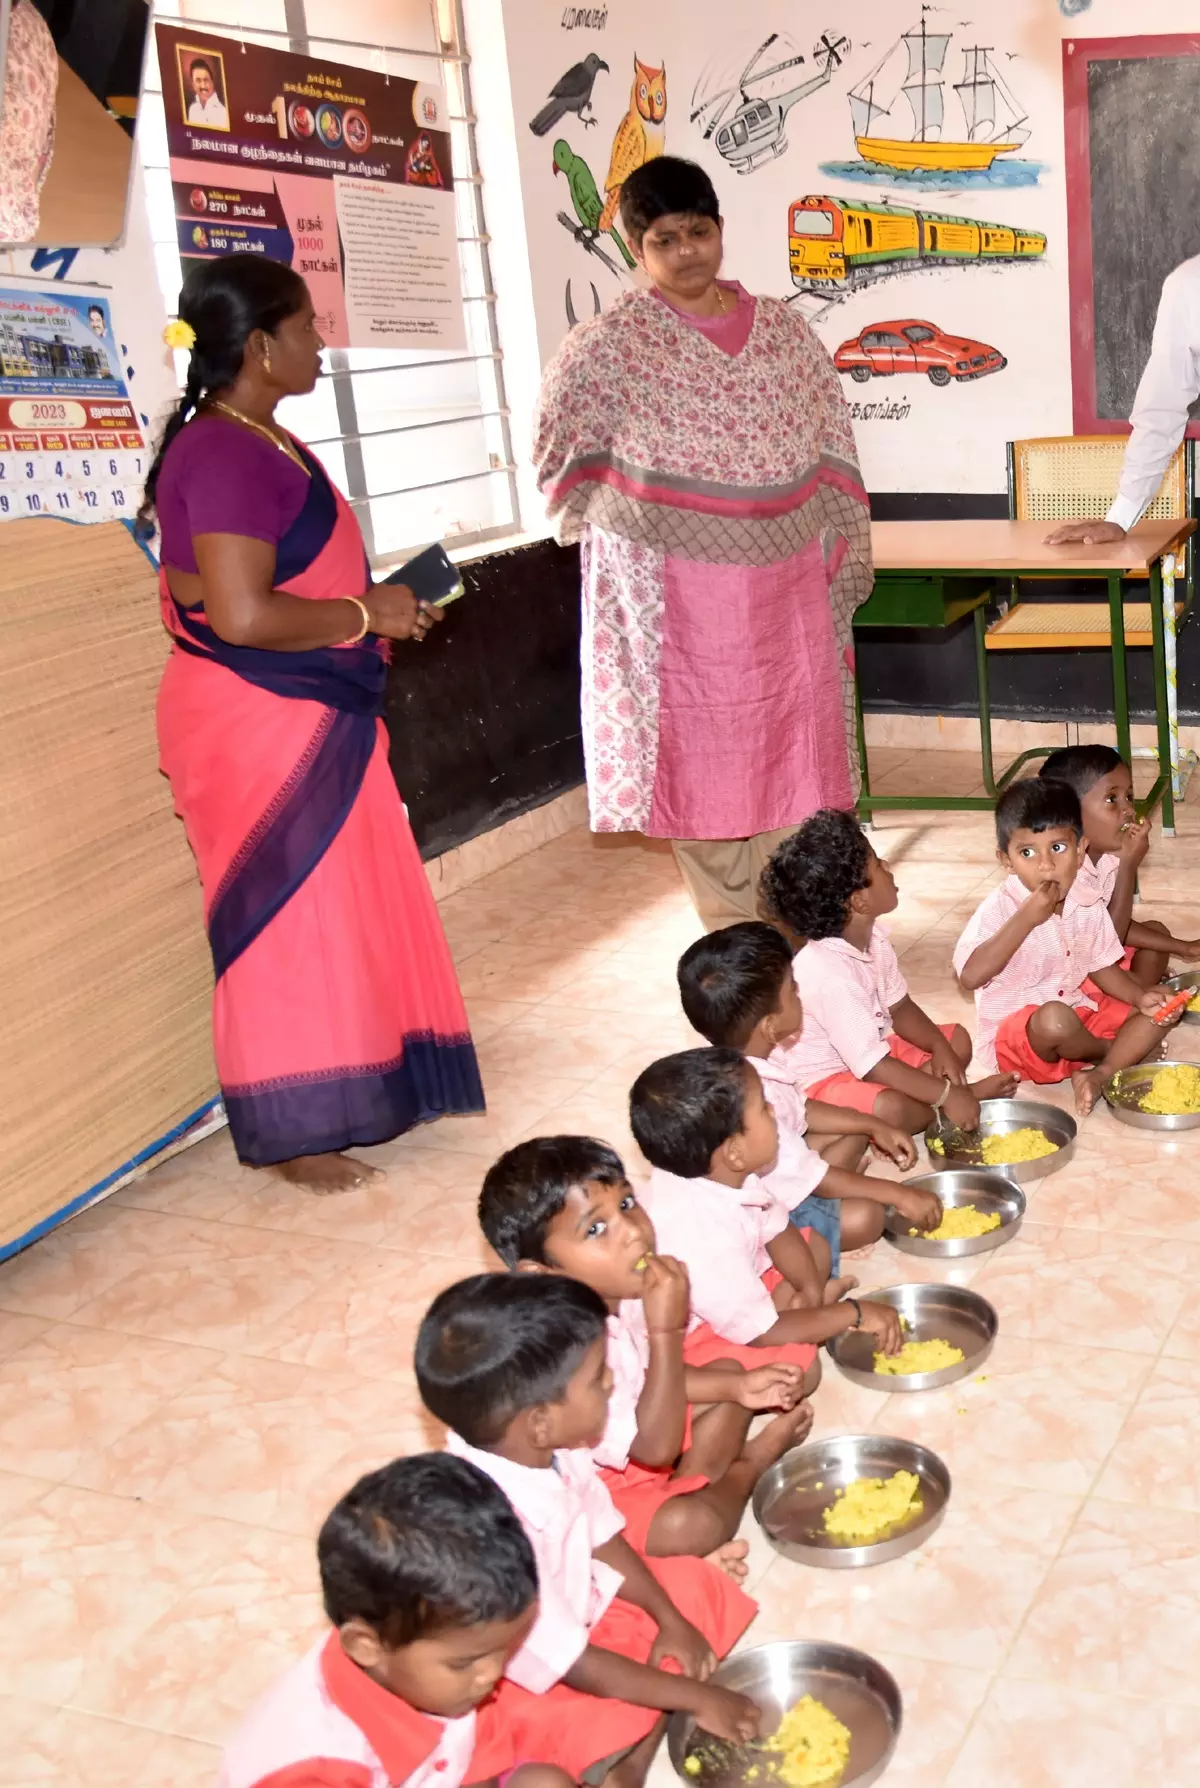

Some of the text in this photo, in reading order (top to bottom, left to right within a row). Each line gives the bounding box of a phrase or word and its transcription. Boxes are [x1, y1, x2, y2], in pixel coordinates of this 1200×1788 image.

[244, 111, 276, 124] முதல்
[372, 133, 404, 147] நாட்கள்
[240, 143, 303, 164] குழந்தைகள்
[304, 154, 346, 170] வளமான
[208, 201, 266, 217] 270 நாட்கள்
[297, 215, 324, 232] முதல்
[210, 238, 265, 252] 180 நாட்கள்
[297, 237, 324, 251] 1000
[300, 255, 339, 273] நாட்கள்
[31, 403, 67, 420] 2023
[89, 403, 133, 419] ஜனவரி
[847, 395, 911, 421] கனங்கள்
[19, 442, 36, 450] TUE
[46, 442, 65, 450] WED
[75, 441, 92, 449] THU
[25, 461, 35, 479] 3
[55, 460, 64, 477] 4
[82, 459, 91, 476] 5
[109, 458, 118, 476] 6
[135, 458, 141, 474] 7
[0, 489, 125, 512] 9 10 11 12 13
